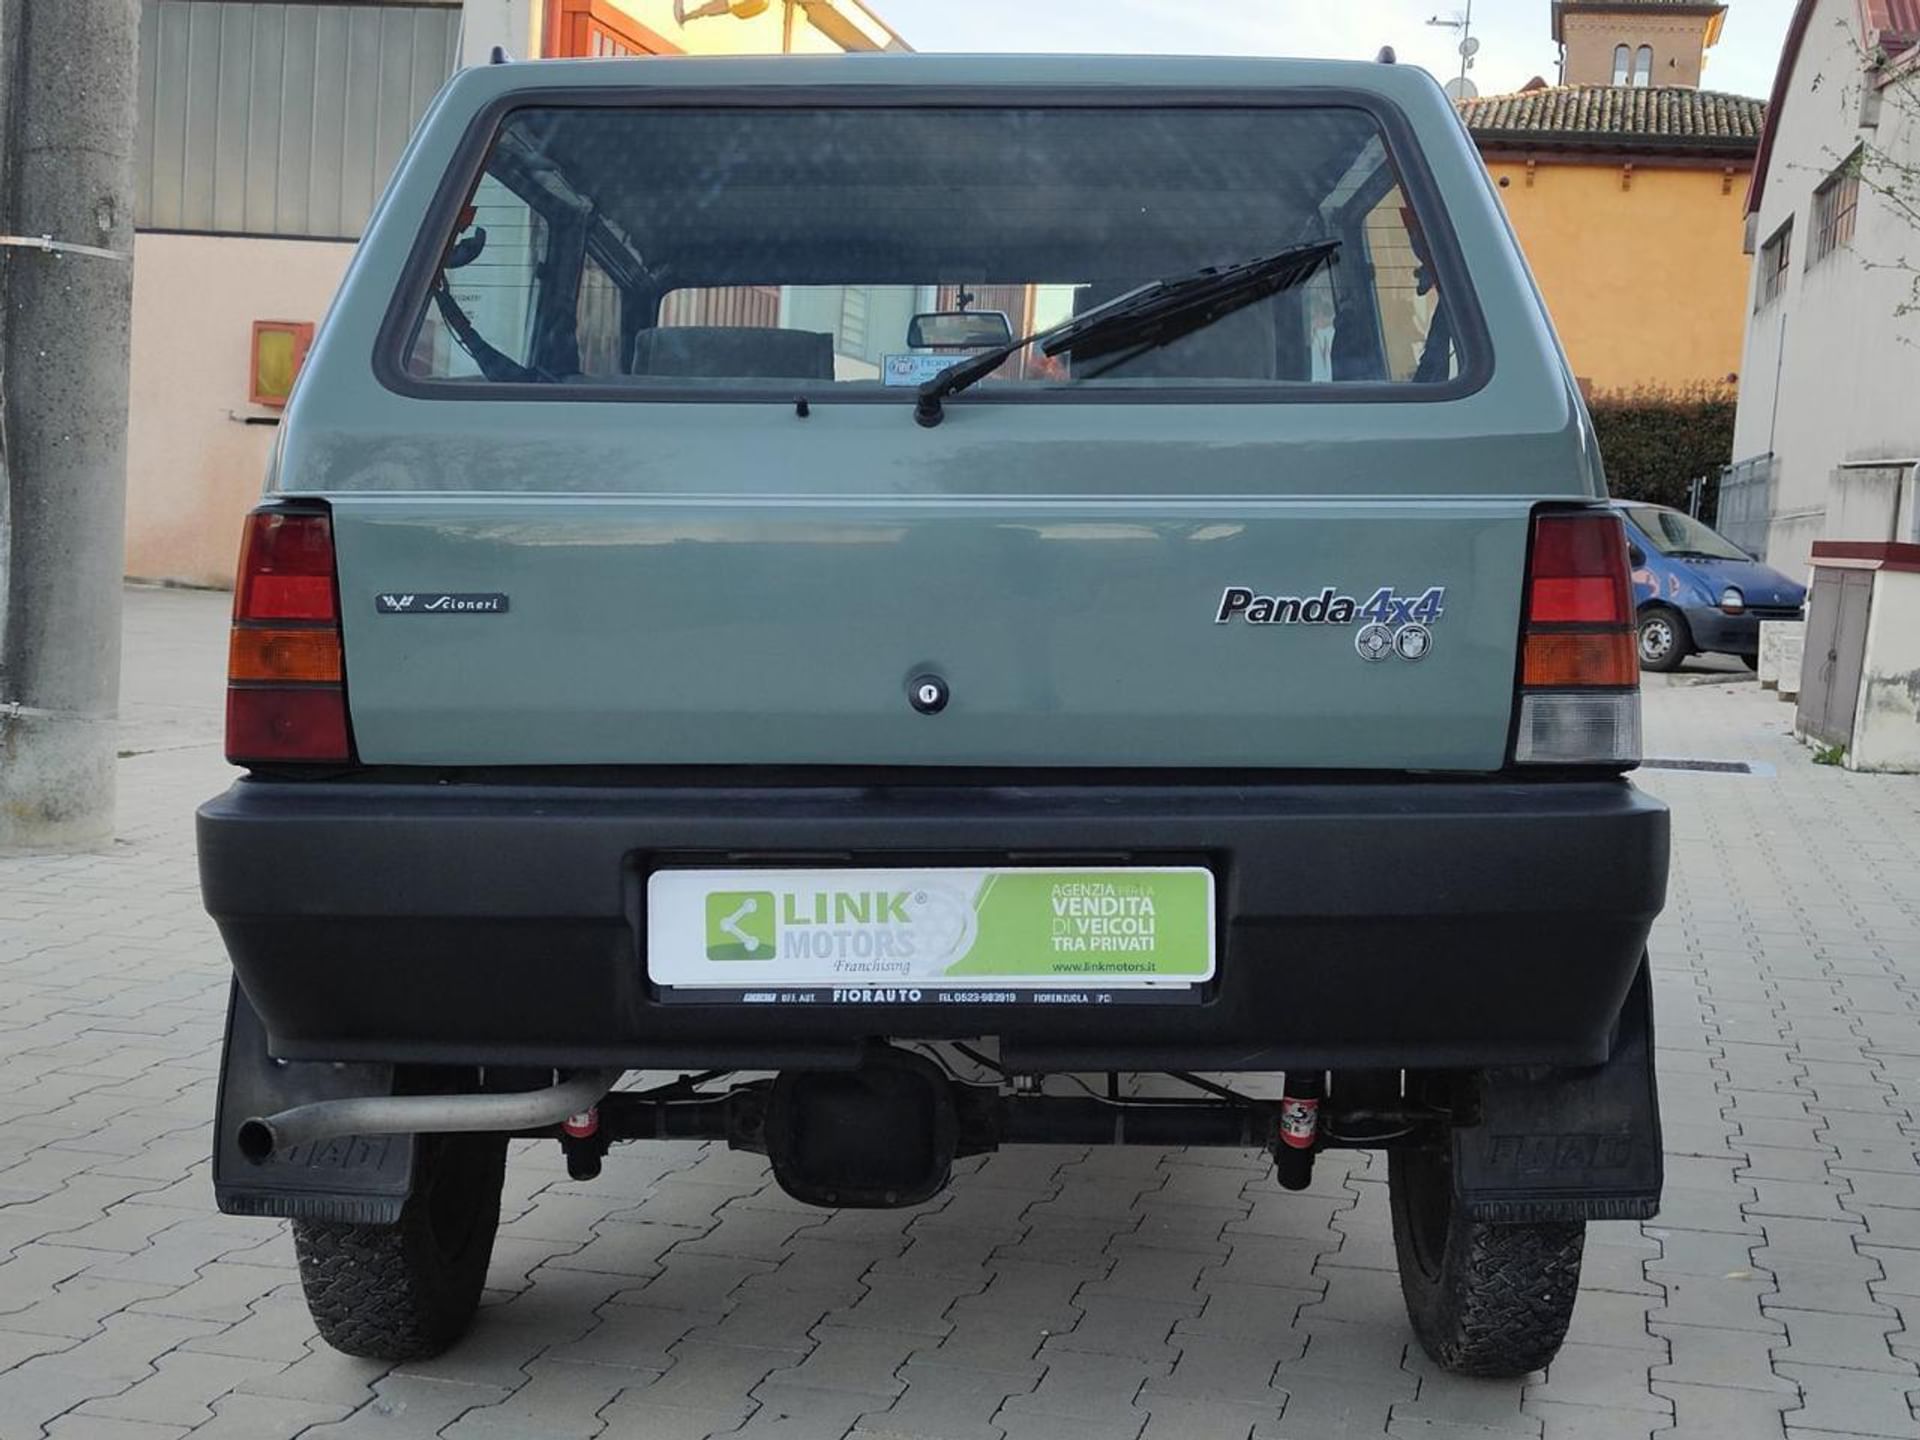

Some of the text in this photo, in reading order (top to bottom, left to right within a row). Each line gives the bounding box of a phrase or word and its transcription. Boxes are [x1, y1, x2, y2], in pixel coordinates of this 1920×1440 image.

[424, 596, 498, 609] Scioneri
[1052, 884, 1115, 897] AGENZIA
[783, 891, 913, 925] LINK
[1052, 897, 1155, 916] VENDITA
[1053, 918, 1155, 935] DI VEICOLI
[783, 931, 915, 959] MOTORS
[1052, 937, 1155, 951] TRA PRIVATI
[833, 958, 911, 976] Franchising
[1052, 961, 1156, 972] www.linkmotors.it
[833, 990, 921, 1002] FIORAUTO
